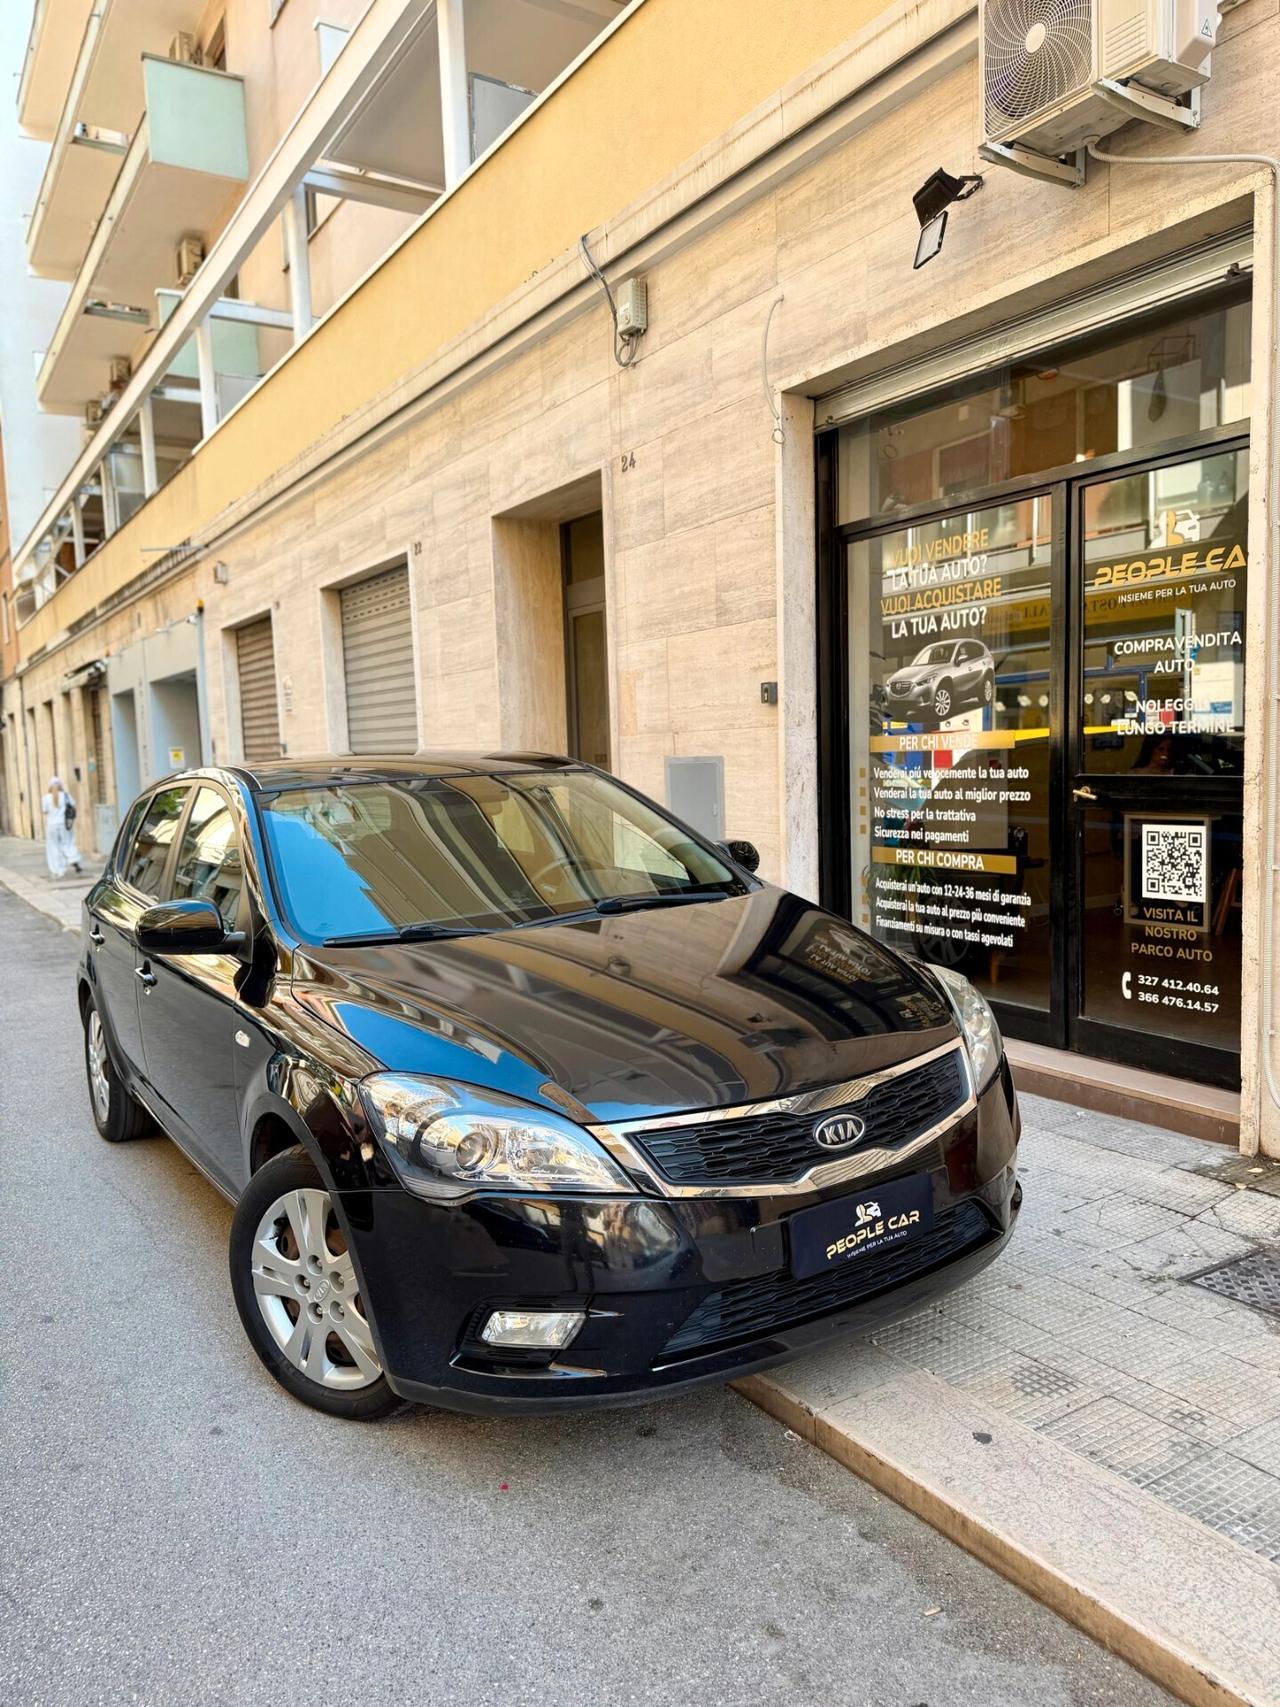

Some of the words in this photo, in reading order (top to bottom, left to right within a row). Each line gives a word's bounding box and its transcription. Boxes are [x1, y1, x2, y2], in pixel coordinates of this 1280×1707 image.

[621, 451, 636, 473] 24
[892, 545, 921, 568] VUOI
[925, 528, 989, 561] VENDERE
[892, 572, 909, 590] LA
[910, 566, 938, 588] TUA
[941, 555, 988, 582] AUTO?
[1094, 552, 1199, 587] PEOPLE
[1206, 544, 1247, 571] CA
[880, 596, 910, 616] VUOI
[910, 577, 1002, 610] ACQUISTARE
[1118, 590, 1152, 603] INSIEME
[1155, 587, 1173, 598] PER
[1175, 585, 1186, 596] LA
[1188, 583, 1208, 594] TUA
[1209, 579, 1237, 591] AUTO
[892, 619, 908, 639] LA
[911, 615, 938, 635] TUA
[941, 606, 987, 631] AUTO?
[1114, 631, 1243, 655] COMPRAVENDITA
[1153, 659, 1196, 674] AUTO
[1135, 698, 1208, 713] NOLEGG
[1117, 720, 1166, 735] LUNGO
[1168, 720, 1236, 735] TERMINE
[899, 736, 920, 750] PER
[920, 735, 938, 749] CHI
[941, 733, 979, 749] VENDE
[874, 767, 907, 779] Venderai
[923, 767, 976, 779] veocemente
[978, 766, 988, 779] la
[989, 767, 1005, 779] tua
[1007, 768, 1029, 779] auto
[874, 787, 907, 799] Venderai
[909, 788, 916, 799] la
[918, 788, 932, 799] tua
[934, 788, 952, 800] auto
[955, 788, 964, 800] al
[966, 788, 997, 803] miglior
[999, 790, 1031, 803] prezzo
[874, 807, 886, 819] No
[886, 808, 909, 819] stress
[911, 810, 925, 822] per
[926, 807, 934, 820] la
[936, 808, 976, 822] trattativa
[874, 828, 910, 840] Sicurezza
[911, 828, 924, 841] nei
[925, 829, 969, 844] pagamenti
[896, 850, 915, 864] PER
[916, 851, 935, 866] CHI
[936, 852, 984, 870] COMPRA
[876, 878, 908, 892] Acquisterai
[908, 881, 930, 894] un'auto
[932, 884, 943, 895] con
[944, 884, 974, 899] 12-24-36
[975, 888, 992, 902] mesi
[992, 889, 1000, 902] di
[1000, 892, 1032, 906] garanzia
[876, 896, 908, 912] Acquisterai
[908, 900, 915, 912] la
[916, 902, 926, 914] tua
[926, 904, 940, 916] auto
[942, 904, 948, 916] al
[949, 908, 970, 920] prezzo
[984, 912, 1026, 928] conveniente
[1143, 906, 1184, 922] VISITA
[1187, 910, 1199, 922] IL
[876, 916, 915, 932] Finanziamenti
[916, 923, 924, 933] su
[924, 922, 944, 937] misura
[946, 928, 950, 938] o
[952, 929, 964, 940] con
[964, 929, 980, 942] tassi
[981, 932, 1014, 948] agevolati
[1145, 926, 1197, 941] NOSTRO
[1131, 943, 1173, 958] PARCO
[1176, 947, 1213, 962] AUTO
[1138, 974, 1159, 986] 327
[1162, 978, 1220, 996] 412.40.64
[1138, 991, 1159, 1004] 366
[1162, 995, 1220, 1014] 476.14.57
[823, 1120, 860, 1144] KIA
[826, 1220, 886, 1260] PEOPLE
[888, 1210, 920, 1230] CAR
[866, 1241, 877, 1250] PER
[894, 1230, 908, 1238] AUTO
